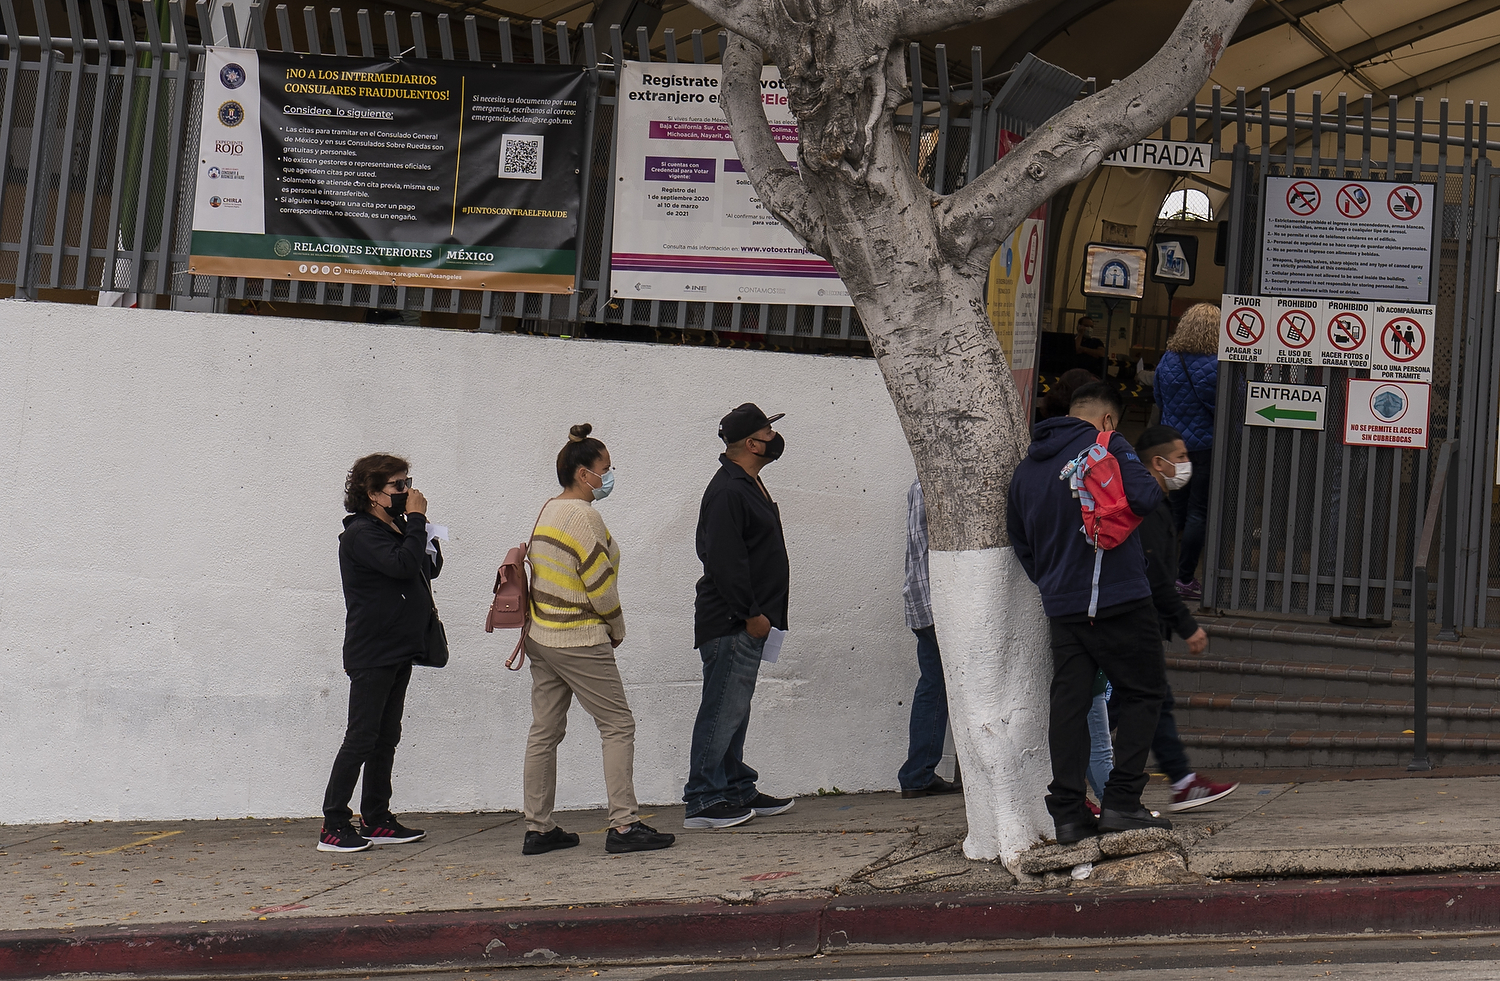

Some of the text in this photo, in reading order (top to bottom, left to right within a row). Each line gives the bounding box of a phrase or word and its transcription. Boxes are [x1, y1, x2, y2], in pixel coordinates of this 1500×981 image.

[286, 68, 437, 85] ¡NO A LOS INTERMEDIARIOS
[642, 74, 718, 88] Regístrate
[285, 83, 450, 100] CONSULARES FRAUDULENTOS!
[629, 89, 704, 104] extranjero
[283, 104, 393, 119] Considere lo siguiente:
[376, 130, 411, 138] Consulado
[215, 143, 244, 155] ROJO
[1102, 142, 1204, 167] NTRADA
[462, 206, 567, 217] #JUNTOSCONTRAELFRAUDE
[294, 242, 494, 262] RELACIONES EXTERIORES MÉXICO
[1234, 297, 1261, 306] FAVOR
[1278, 299, 1317, 308] PROHIBIDO
[1329, 301, 1368, 311] PROHIBIDO
[1385, 306, 1432, 314] ACOMPAÑANTES
[1225, 346, 1251, 354] APAGAR
[1229, 353, 1257, 364] CELULAR
[1277, 356, 1312, 364] CELULARES
[1348, 359, 1367, 369] VIDEO
[1251, 386, 1322, 402] ENTRADA
[1399, 426, 1422, 434] ACCESO
[1362, 433, 1411, 443] SIN CUBREBOCAS
